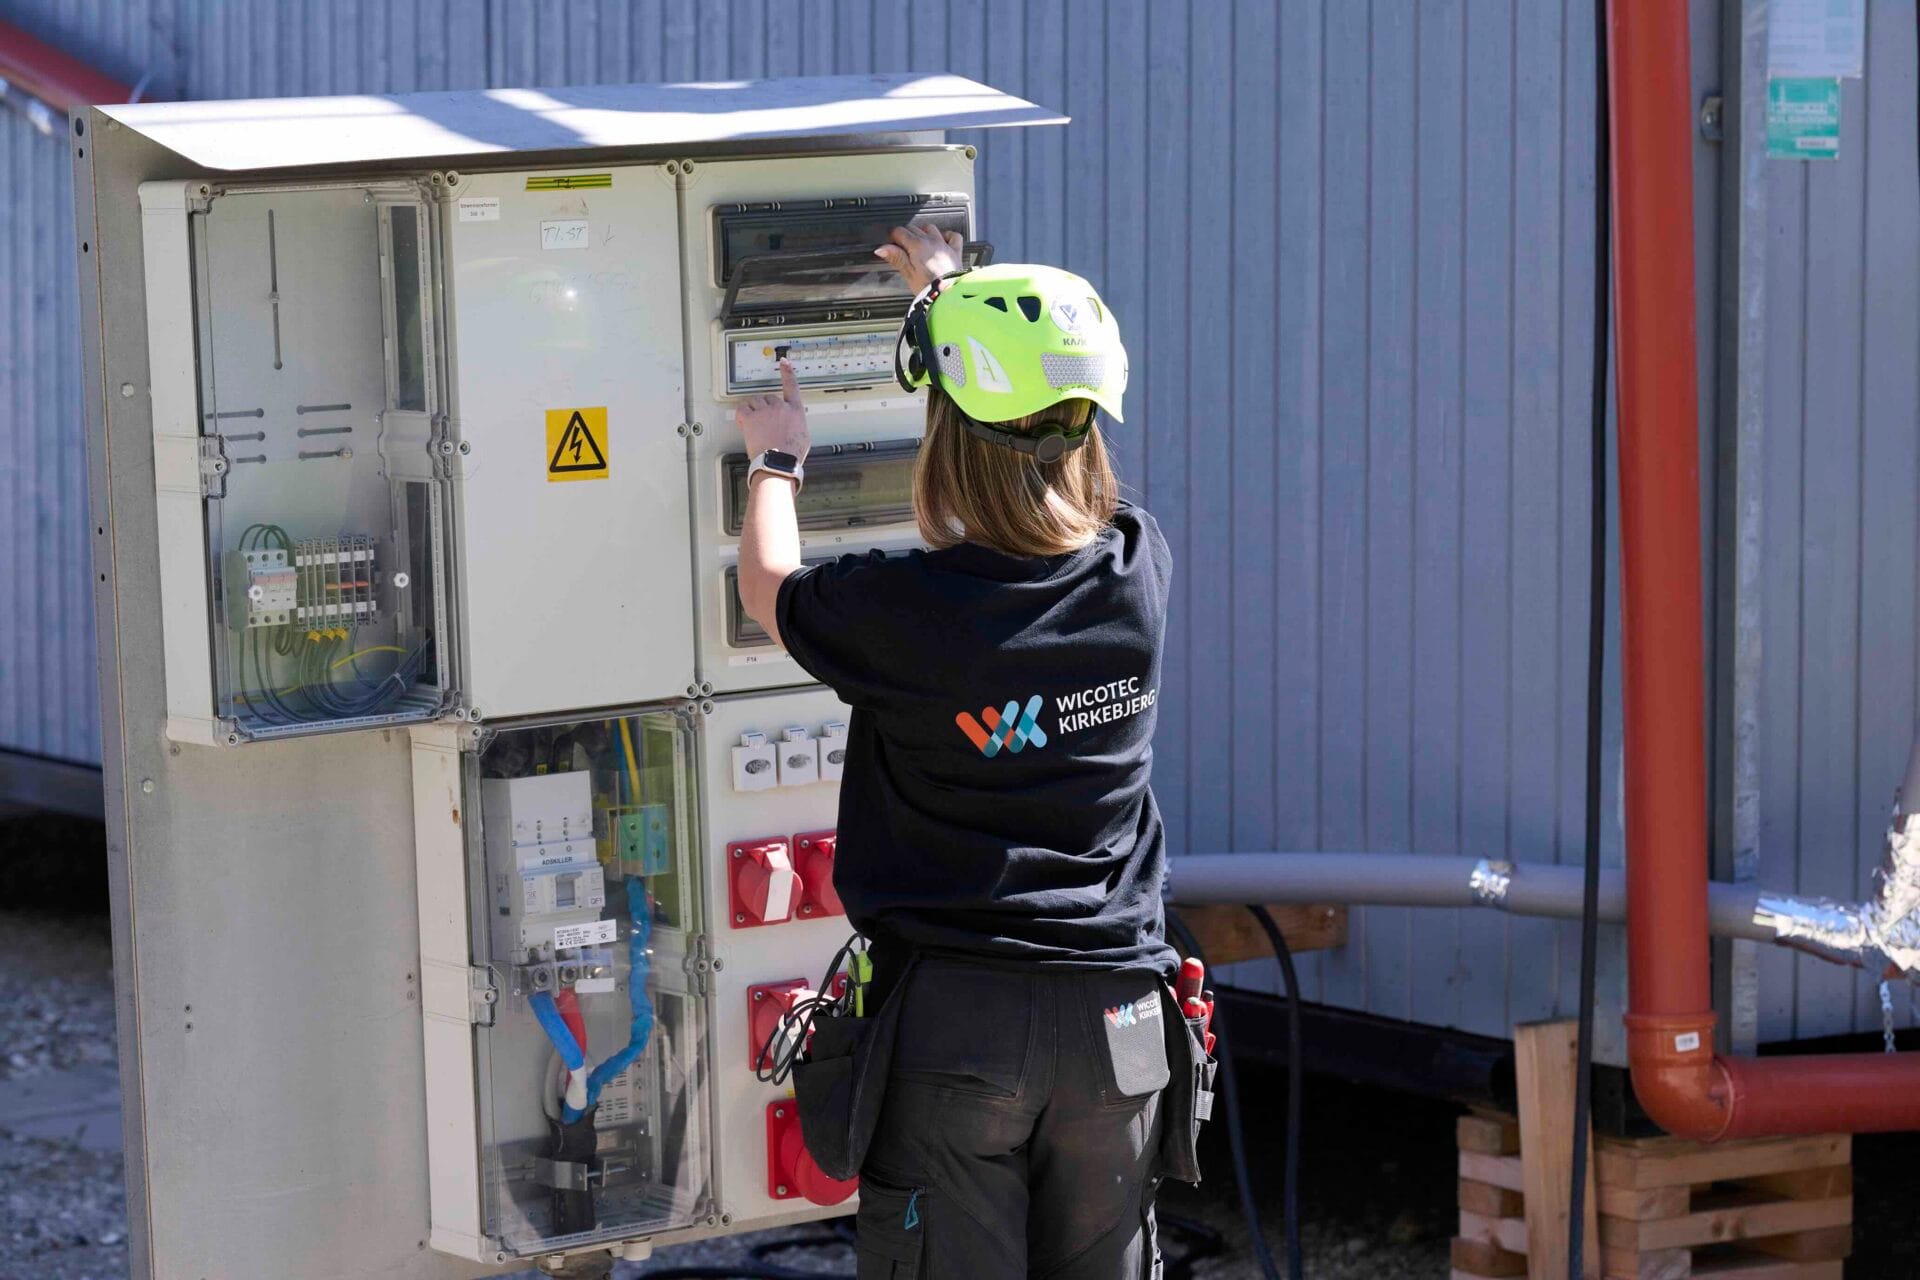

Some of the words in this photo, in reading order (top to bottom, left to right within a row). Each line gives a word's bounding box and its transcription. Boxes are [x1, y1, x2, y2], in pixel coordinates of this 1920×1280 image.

[1055, 676, 1140, 713] WICOTEC
[1059, 689, 1156, 735] KIRKEBJERG
[542, 856, 573, 866] ADSKILLER
